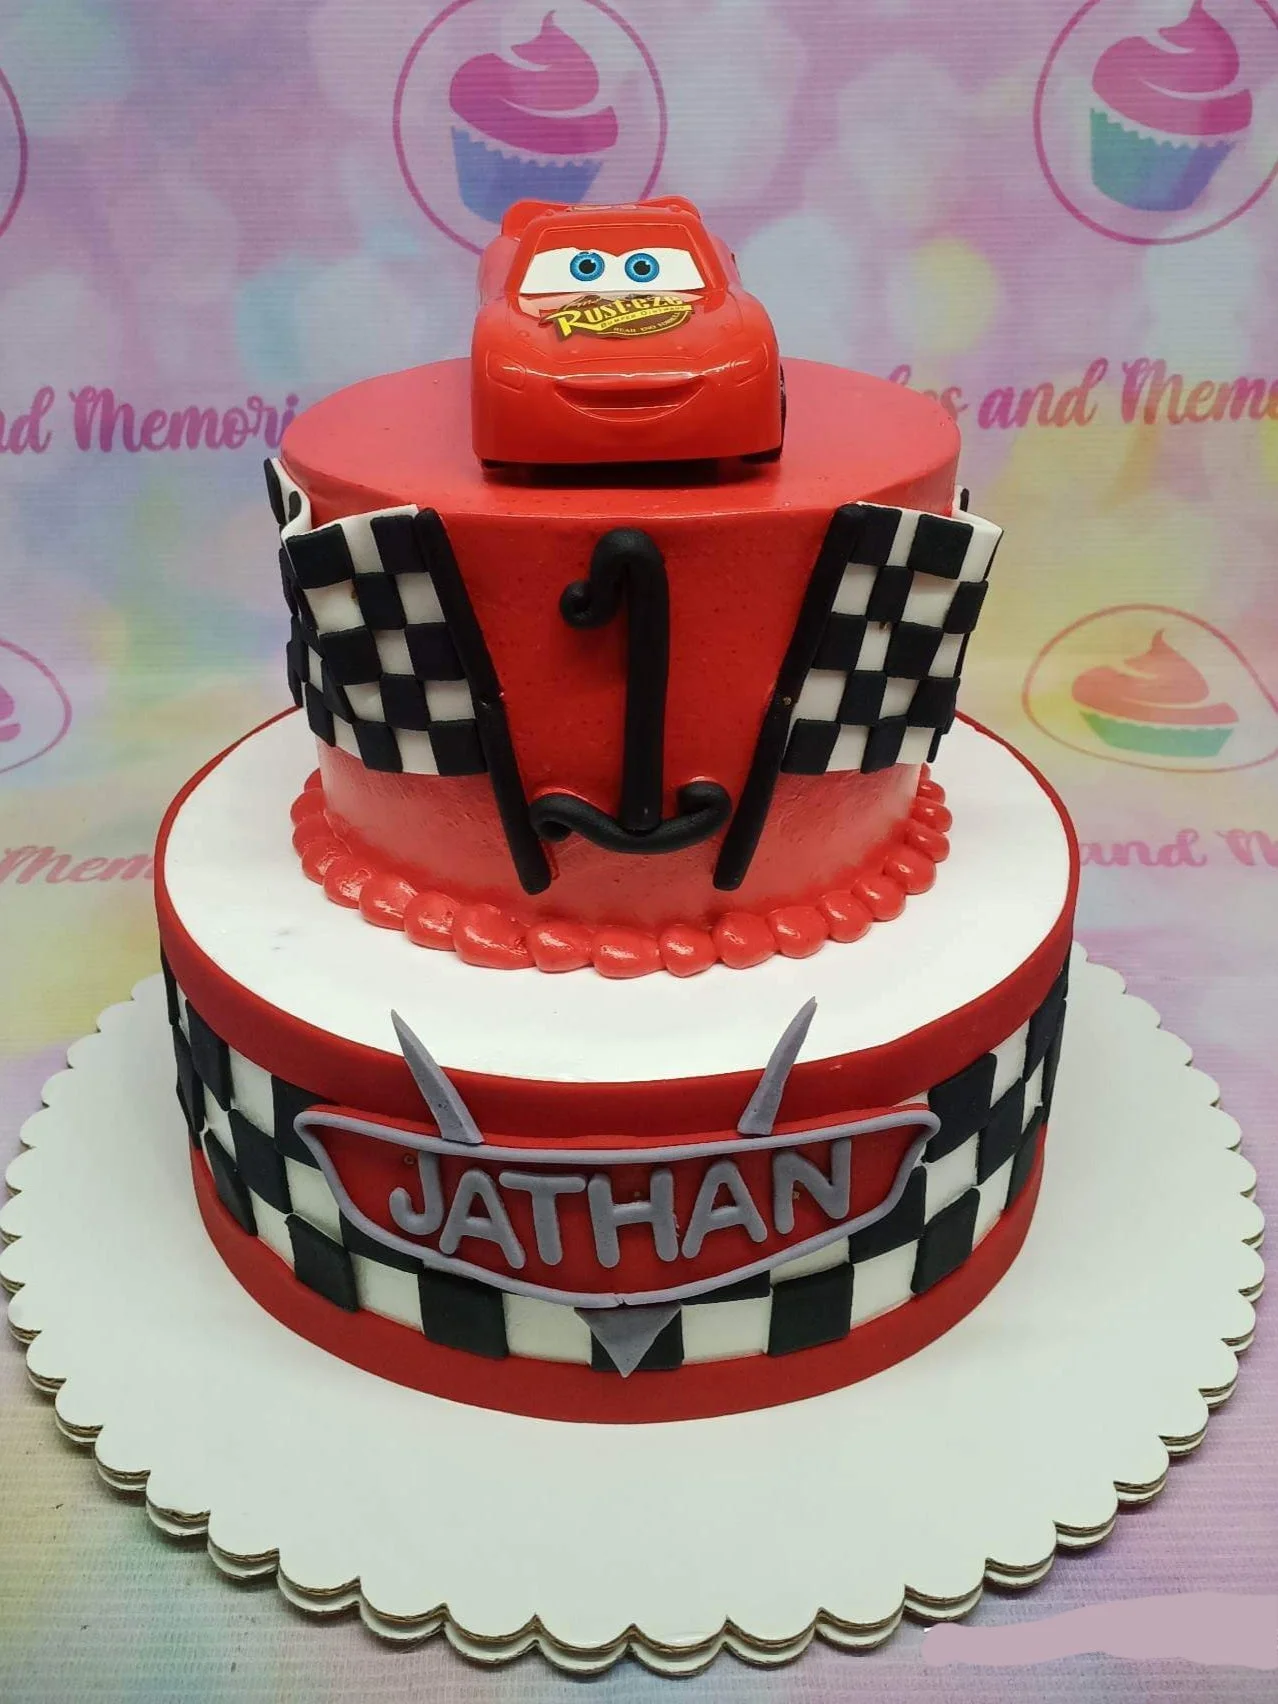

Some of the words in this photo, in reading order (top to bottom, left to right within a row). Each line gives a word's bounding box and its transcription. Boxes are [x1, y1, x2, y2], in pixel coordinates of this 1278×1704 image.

[977, 357, 1109, 430] and
[529, 526, 733, 856] 1
[387, 1137, 853, 1270] JATHAN
